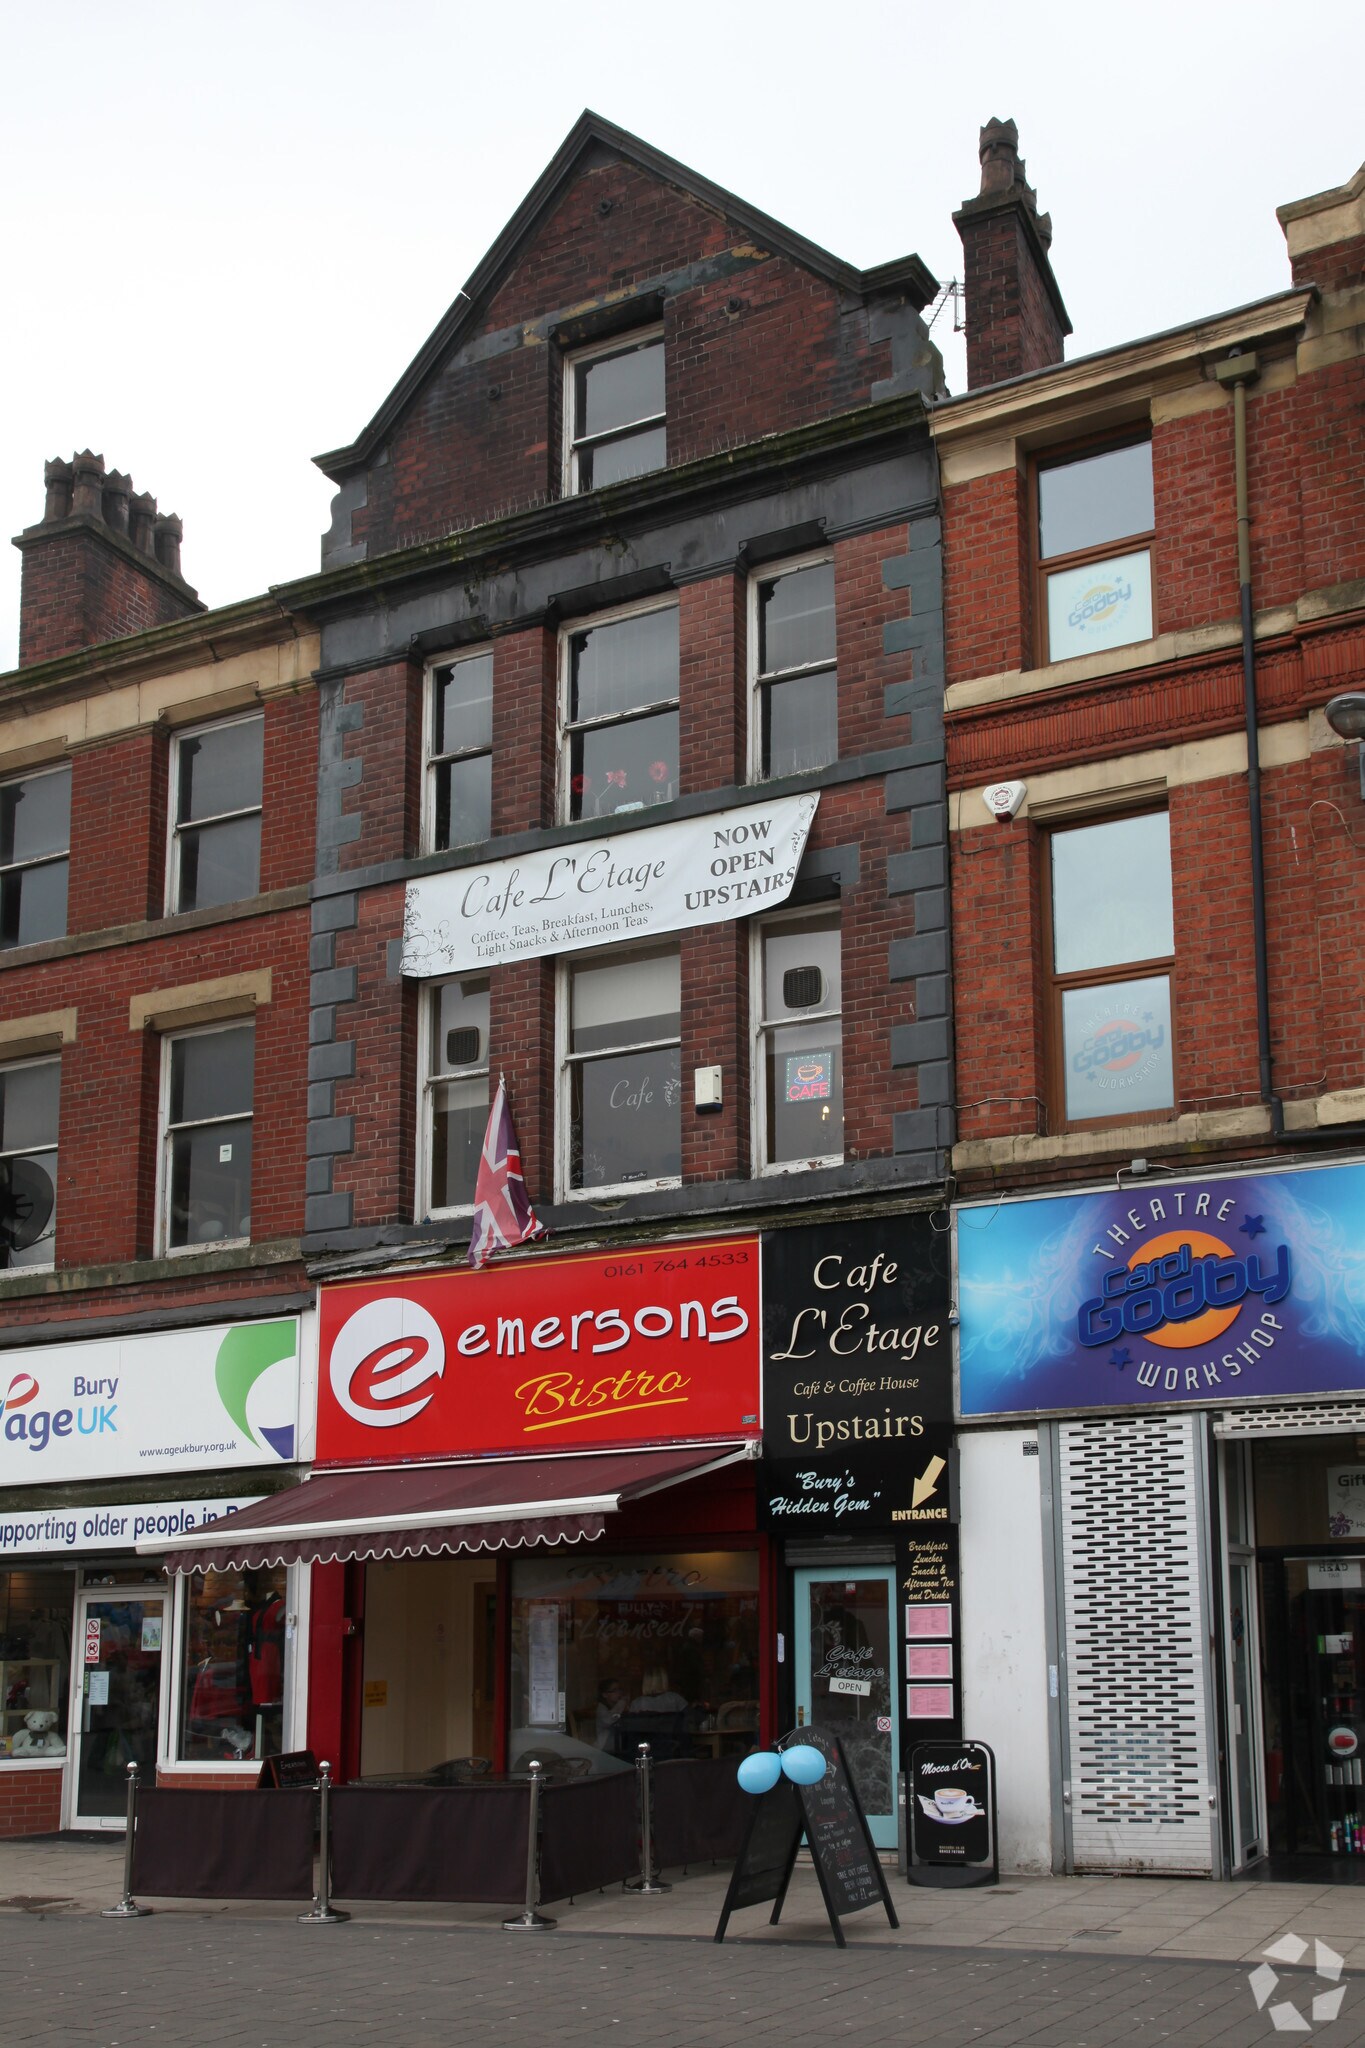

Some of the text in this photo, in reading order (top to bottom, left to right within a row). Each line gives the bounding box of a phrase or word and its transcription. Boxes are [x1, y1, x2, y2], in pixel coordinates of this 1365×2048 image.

[1068, 584, 1131, 627] Godby
[713, 819, 772, 849] NOW
[710, 847, 776, 877] OPEN
[461, 849, 666, 920] Cafe L'Etage
[684, 866, 797, 911] UPSTAIRS
[471, 901, 654, 945] Coffee, Teas, Breakfast, Lunches,
[476, 915, 649, 957] Light Snacks & Afternoon Teas
[1080, 1003, 1141, 1034] THEATRE
[1072, 1024, 1165, 1073] Godby
[1098, 1053, 1161, 1090] WORKSHOP
[610, 1076, 653, 1111] Cafe
[789, 1081, 829, 1100] CAFE
[1092, 1192, 1236, 1259] THEATRE
[605, 1251, 749, 1278] 0161 764 4533
[813, 1252, 898, 1294] Cafe
[1102, 1243, 1193, 1298] Carol
[1077, 1243, 1292, 1347] Godby
[457, 1296, 750, 1356] emersons
[769, 1303, 940, 1361] L'Etage
[1136, 1312, 1284, 1390] WORKSHOP
[73, 1376, 119, 1399] Bury
[515, 1369, 691, 1416] Bistro
[793, 1376, 920, 1399] Café & Coffee House
[786, 1407, 924, 1449] Upstairs
[139, 1440, 237, 1458] www.ageukbury.org.uk
[769, 1496, 830, 1516] Hidden
[891, 1508, 948, 1521] ENTRANCE
[83, 1513, 128, 1537] older
[134, 1508, 195, 1540] people
[908, 1540, 949, 1553] Breakfasts
[913, 1553, 943, 1563] Lunches
[911, 1564, 946, 1576] Snacks &
[1319, 1562, 1349, 1573] HEAD
[903, 1576, 954, 1591] Afternoon Tea
[908, 1589, 950, 1600] and Drinks
[580, 1603, 693, 1639] Licensed
[826, 1644, 873, 1664] Café
[814, 1662, 885, 1681] L'etage
[838, 1681, 862, 1692] OPEN
[921, 1757, 973, 1775] Mocca d'Or
